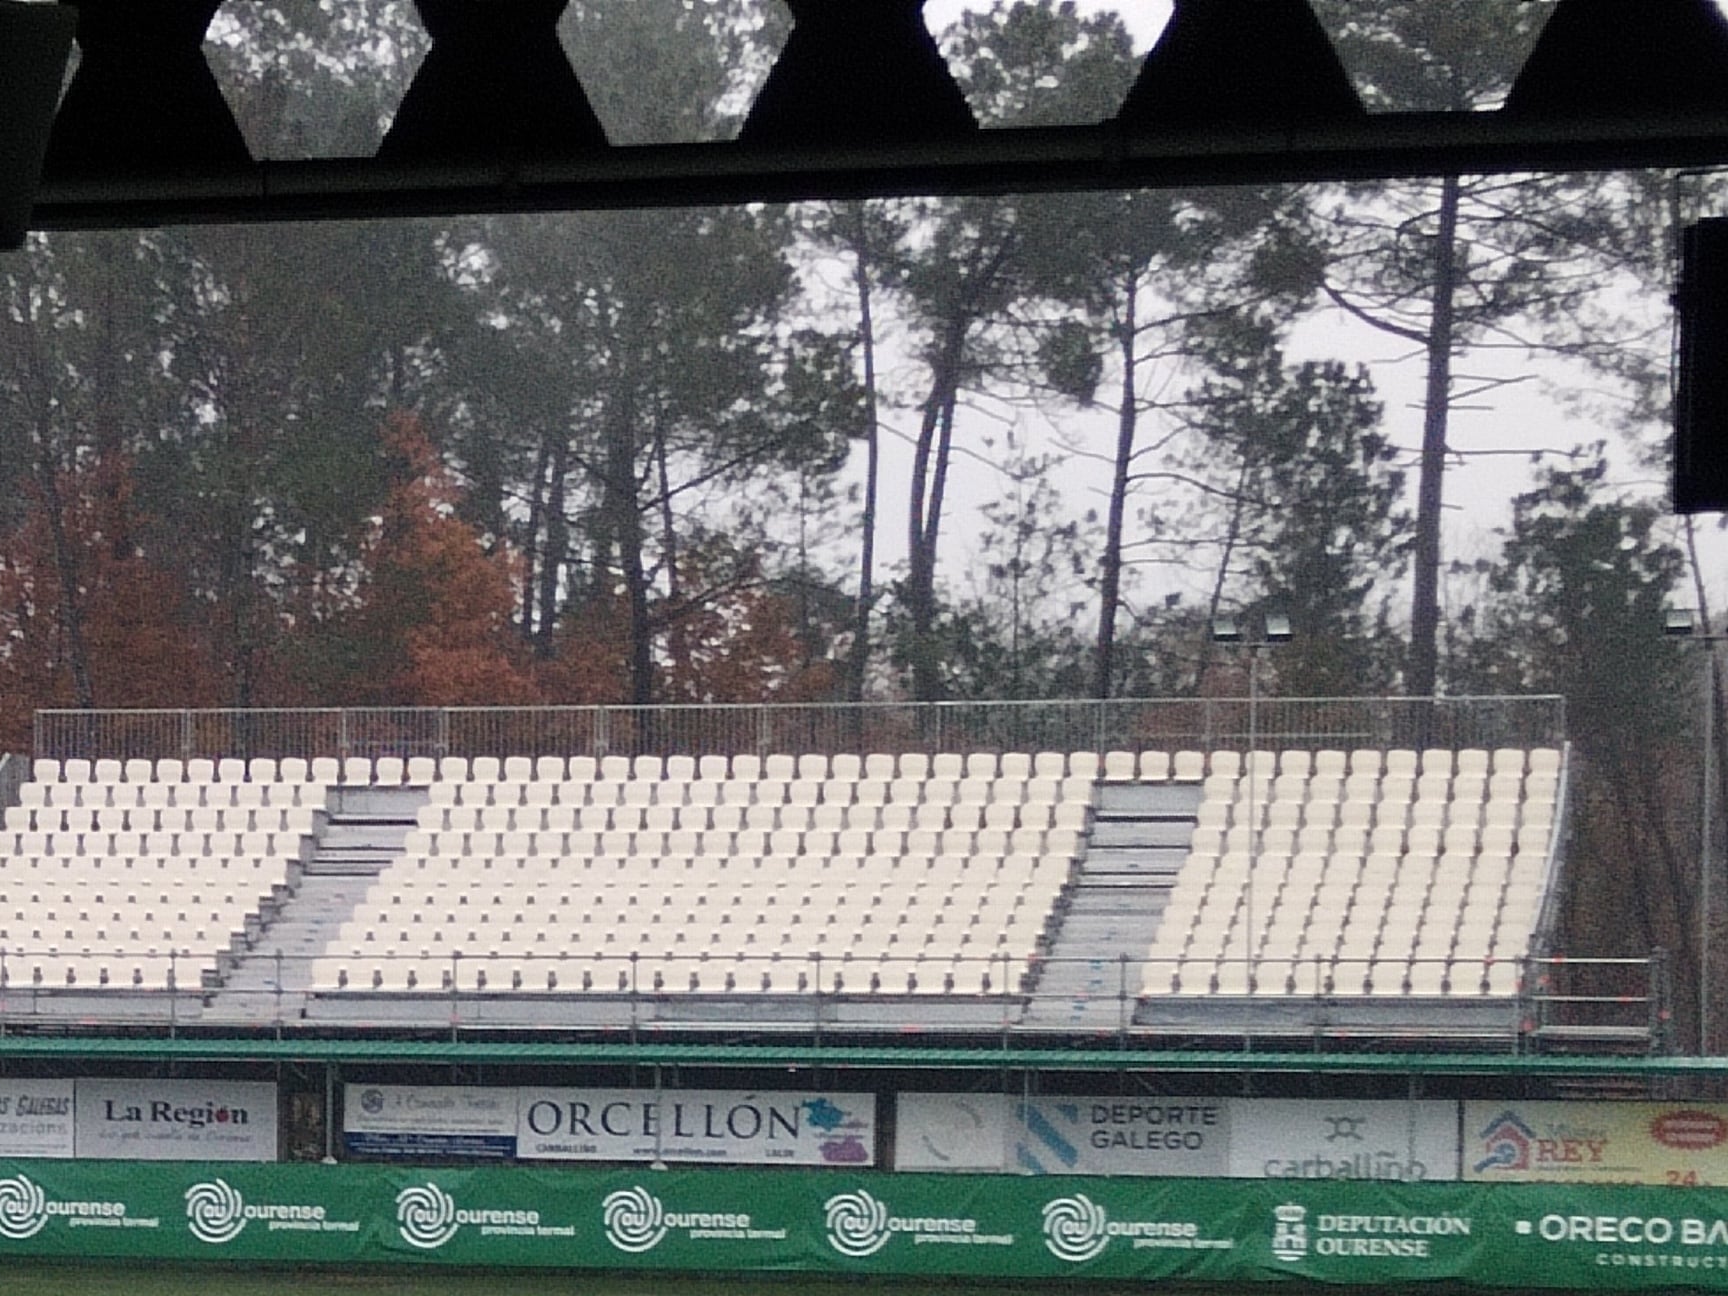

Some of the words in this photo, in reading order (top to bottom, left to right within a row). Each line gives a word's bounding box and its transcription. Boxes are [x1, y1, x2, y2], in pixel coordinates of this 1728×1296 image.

[104, 1100, 142, 1122] La
[151, 1100, 248, 1128] Región
[528, 1095, 800, 1139] ORCELLÓN
[1091, 1104, 1217, 1125] DEPORTE
[1090, 1129, 1203, 1150] GALEGO
[1536, 1138, 1609, 1162] REY
[1264, 1150, 1428, 1181] carballiño
[46, 1201, 125, 1216] ourense
[244, 1205, 326, 1219] ourense
[456, 1210, 539, 1224] ourense
[664, 1213, 750, 1227] ourense
[888, 1217, 976, 1232] ourense
[1107, 1222, 1198, 1236] ourense
[1317, 1211, 1471, 1235] DEPUTACIÓN
[1539, 1214, 1673, 1243] ORECO
[1316, 1237, 1429, 1257] OURENSE
